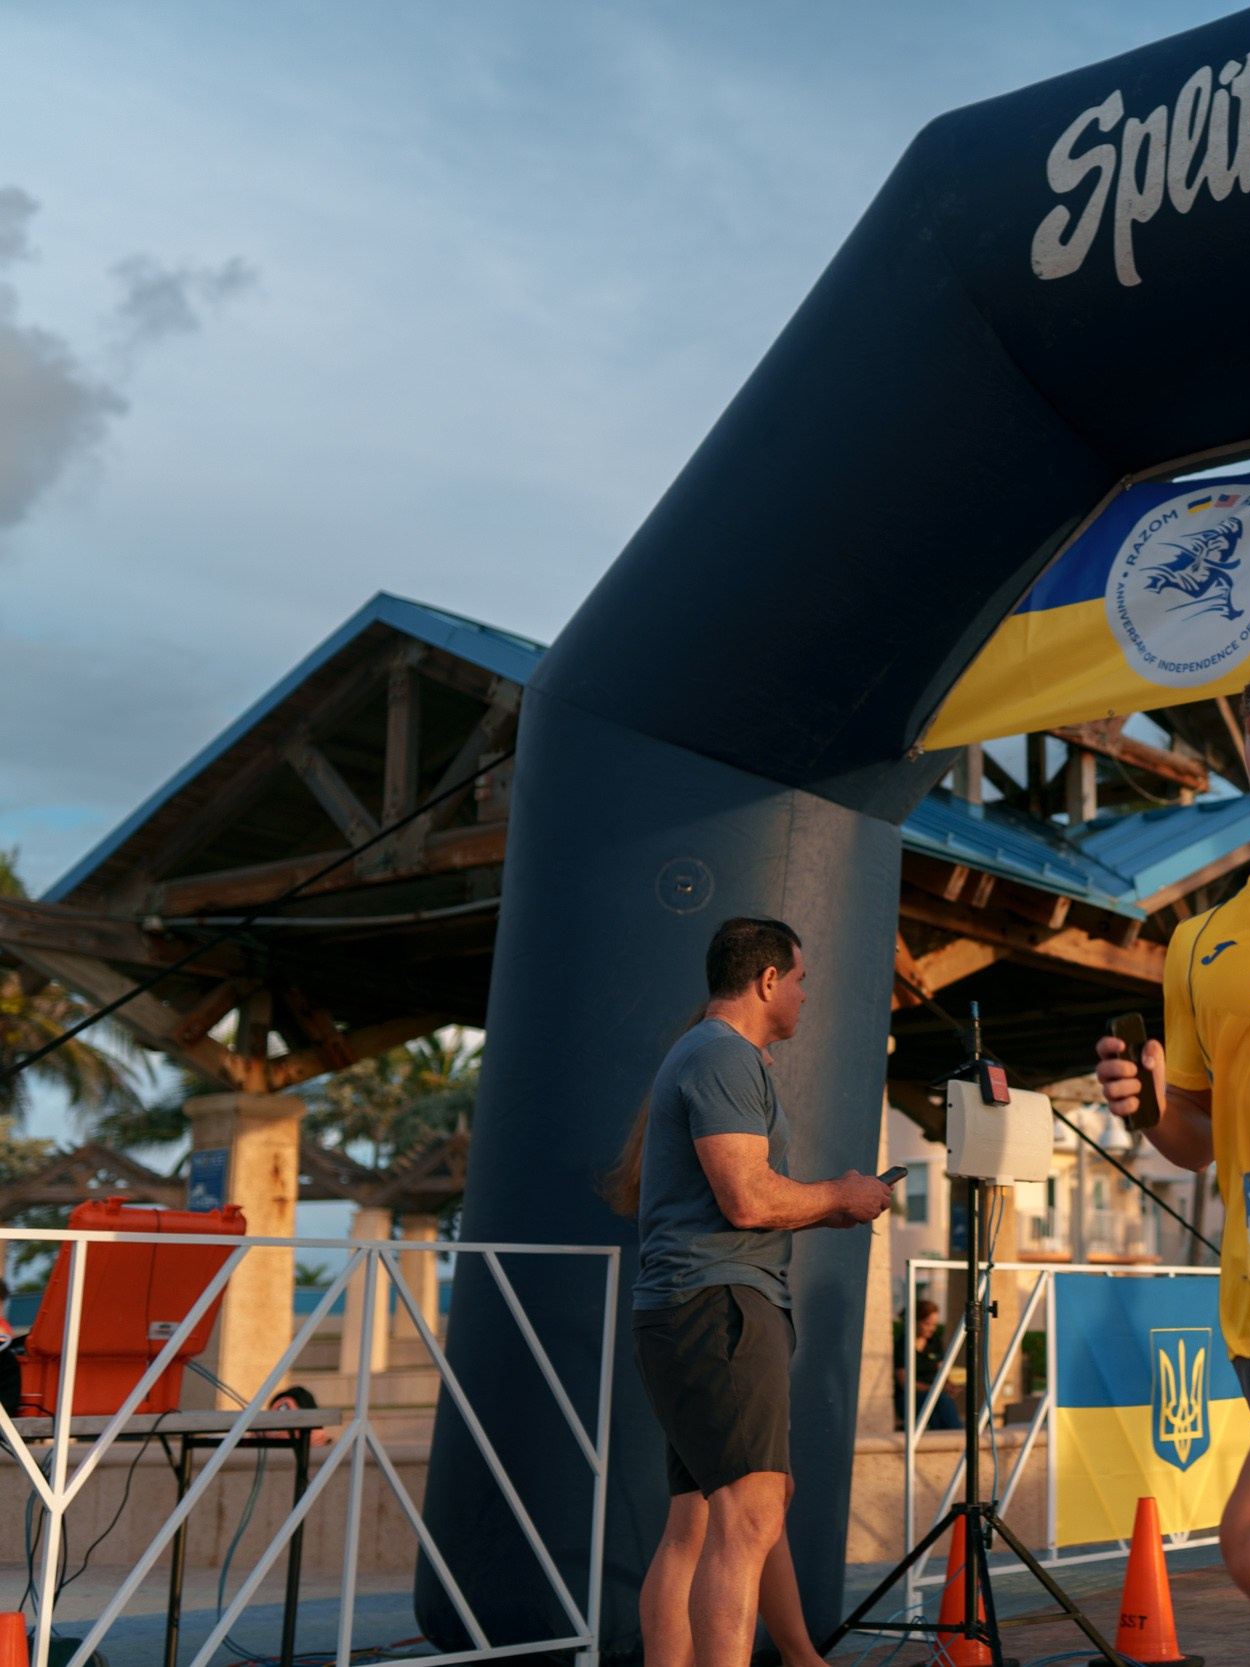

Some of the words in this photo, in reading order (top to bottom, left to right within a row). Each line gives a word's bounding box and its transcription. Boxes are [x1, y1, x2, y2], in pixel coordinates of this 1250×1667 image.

[1125, 508, 1179, 567] RAZOM
[1143, 652, 1158, 665] OF
[1157, 639, 1240, 673] INDEPENDENCE
[1120, 1613, 1148, 1630] SST
